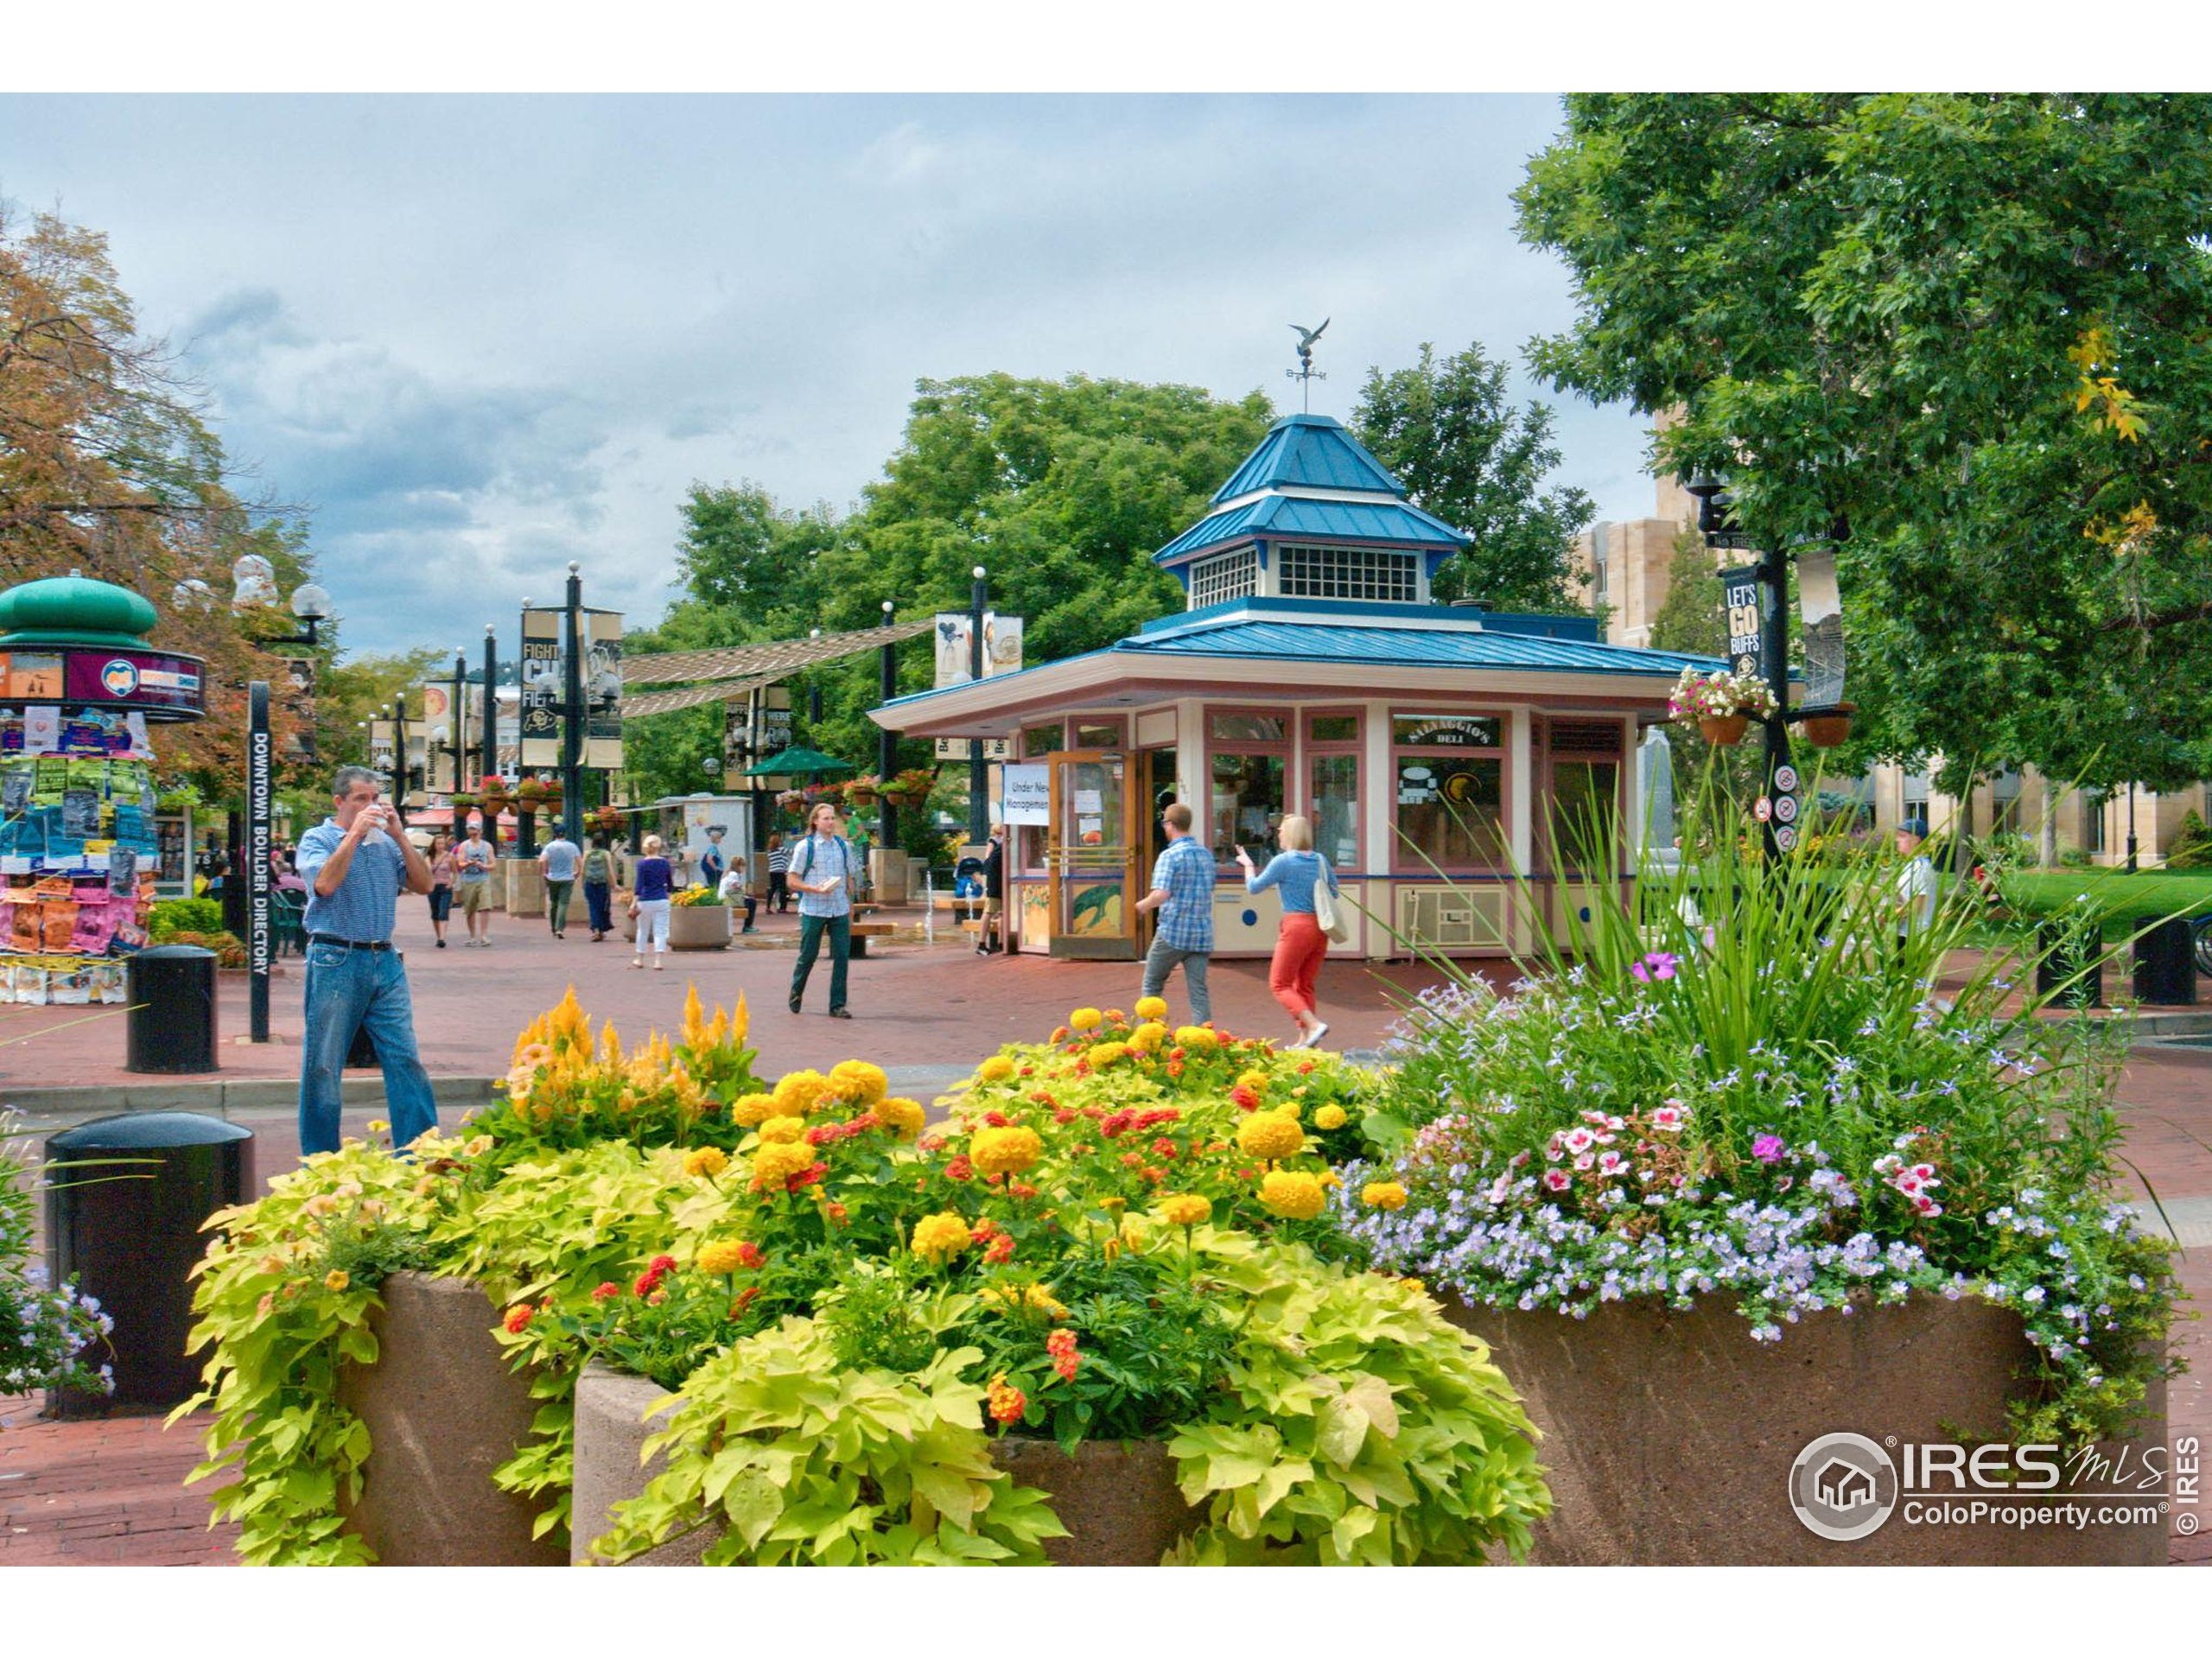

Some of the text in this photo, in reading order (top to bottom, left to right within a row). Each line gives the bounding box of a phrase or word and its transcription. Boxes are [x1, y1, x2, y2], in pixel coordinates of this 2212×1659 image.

[1726, 583, 1757, 608] LET'S
[1729, 605, 1759, 638] GO
[524, 644, 559, 659] FIGHT
[1731, 633, 1760, 656] BUFFS
[1437, 734, 1464, 743] DELI
[1011, 780, 1033, 792] Under
[1006, 798, 1049, 812] Managemen
[253, 733, 268, 976] DOWNTOWN BOULDER DIRECTORY
